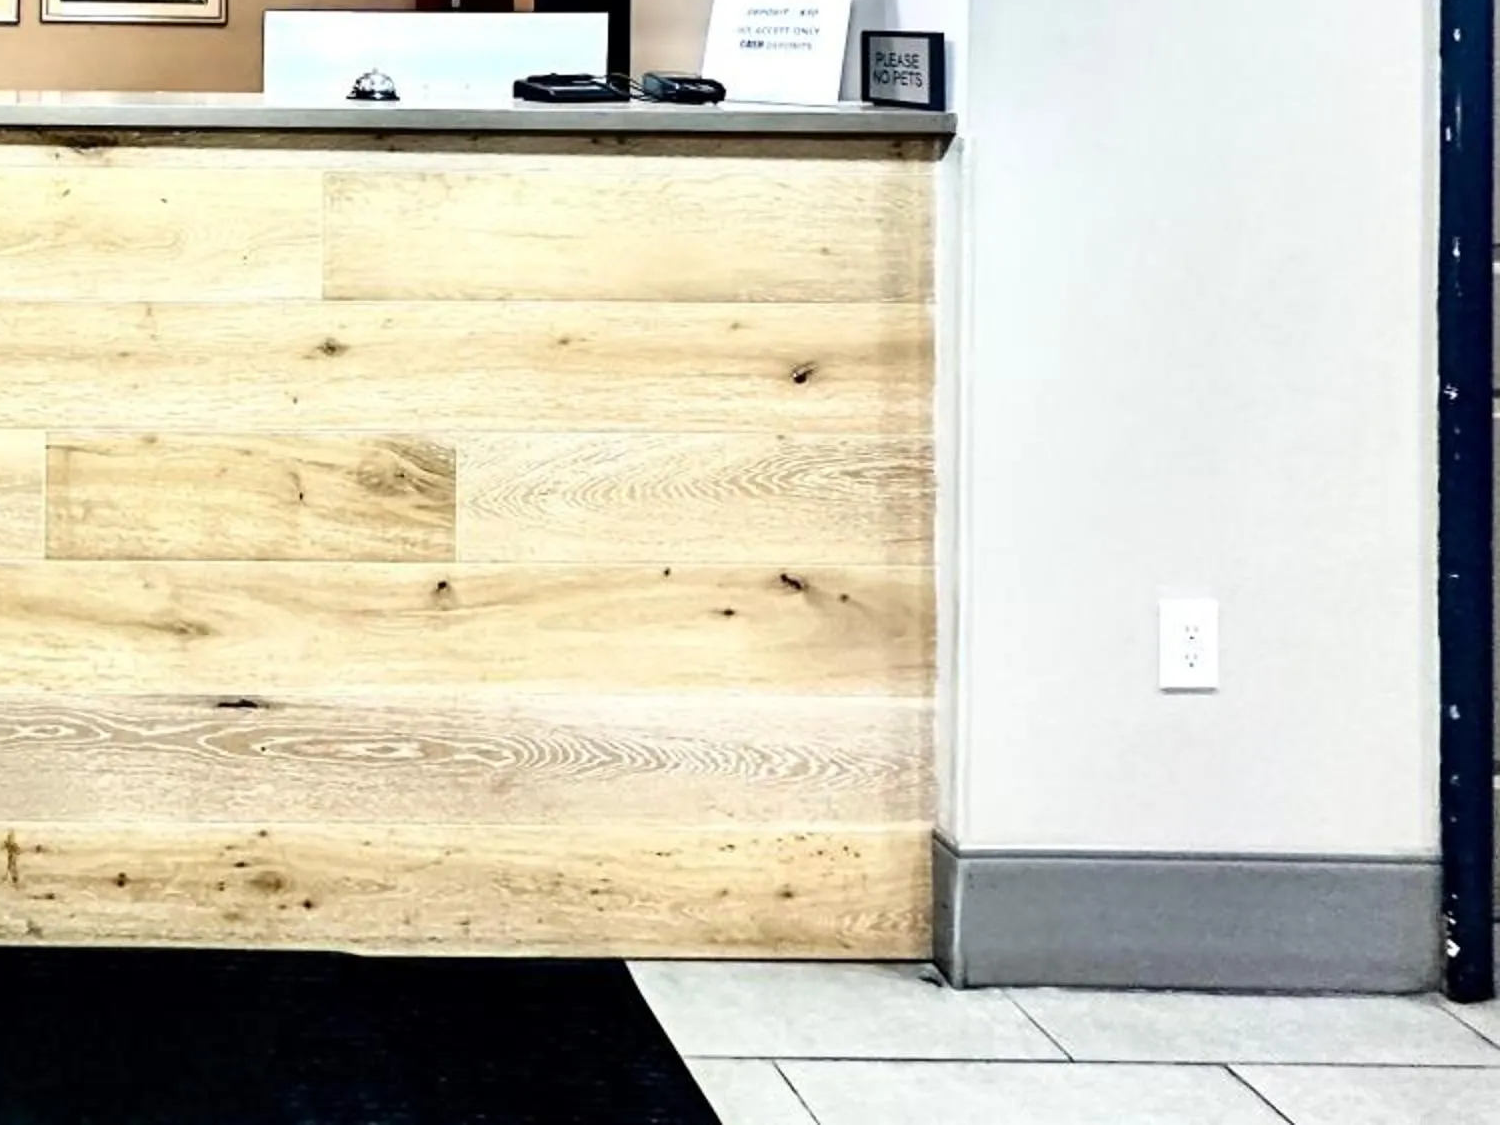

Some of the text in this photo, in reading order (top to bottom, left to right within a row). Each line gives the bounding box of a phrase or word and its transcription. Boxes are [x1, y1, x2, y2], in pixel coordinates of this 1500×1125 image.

[793, 26, 820, 36] ONLY
[739, 39, 764, 49] CASH
[874, 51, 920, 69] PLEASE
[873, 69, 922, 87] NO PETS
